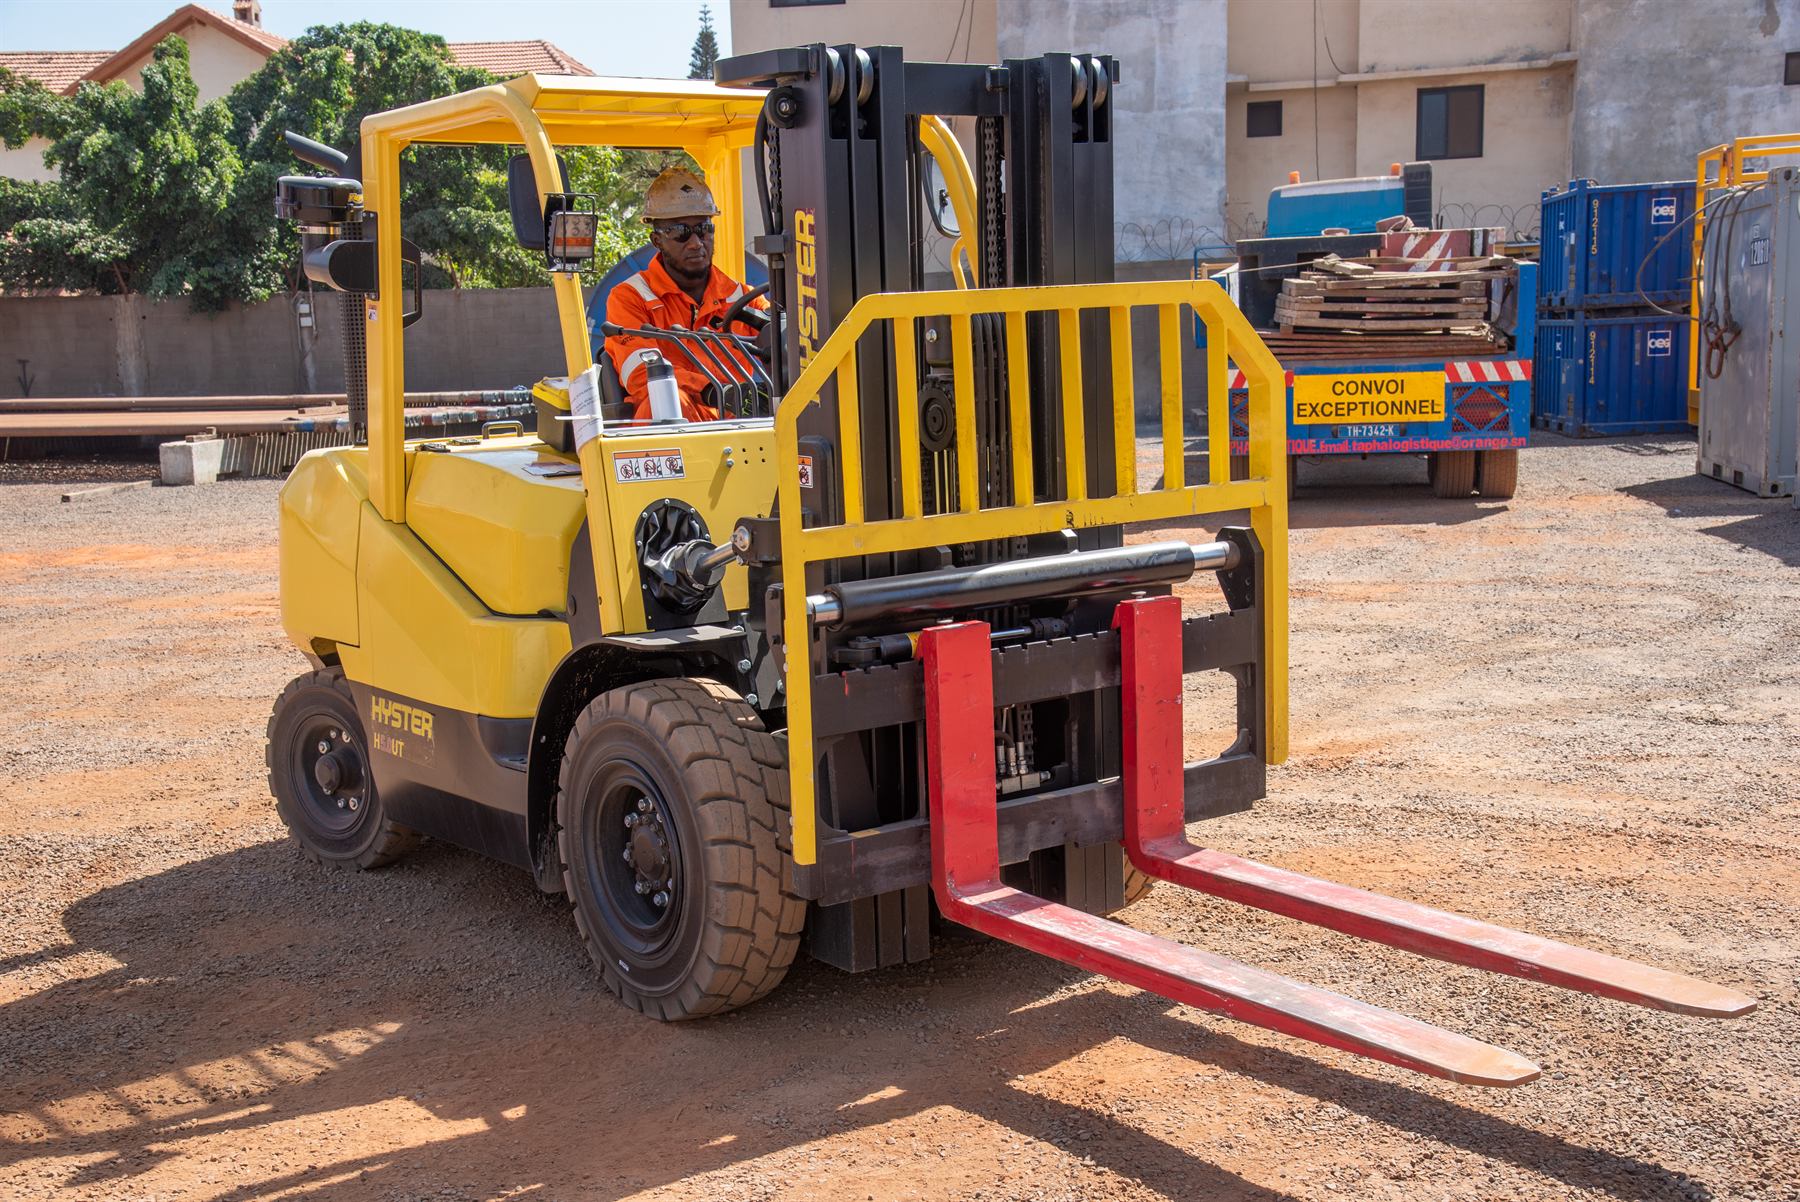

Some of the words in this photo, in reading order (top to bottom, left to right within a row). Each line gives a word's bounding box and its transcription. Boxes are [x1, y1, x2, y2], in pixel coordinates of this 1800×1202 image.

[794, 208, 820, 372] YSTER
[1332, 379, 1405, 396] CONVOI
[1296, 399, 1441, 418] EXCEPTIONNEL
[1347, 425, 1394, 437] TH-7342-K
[371, 695, 434, 740] HYSTER
